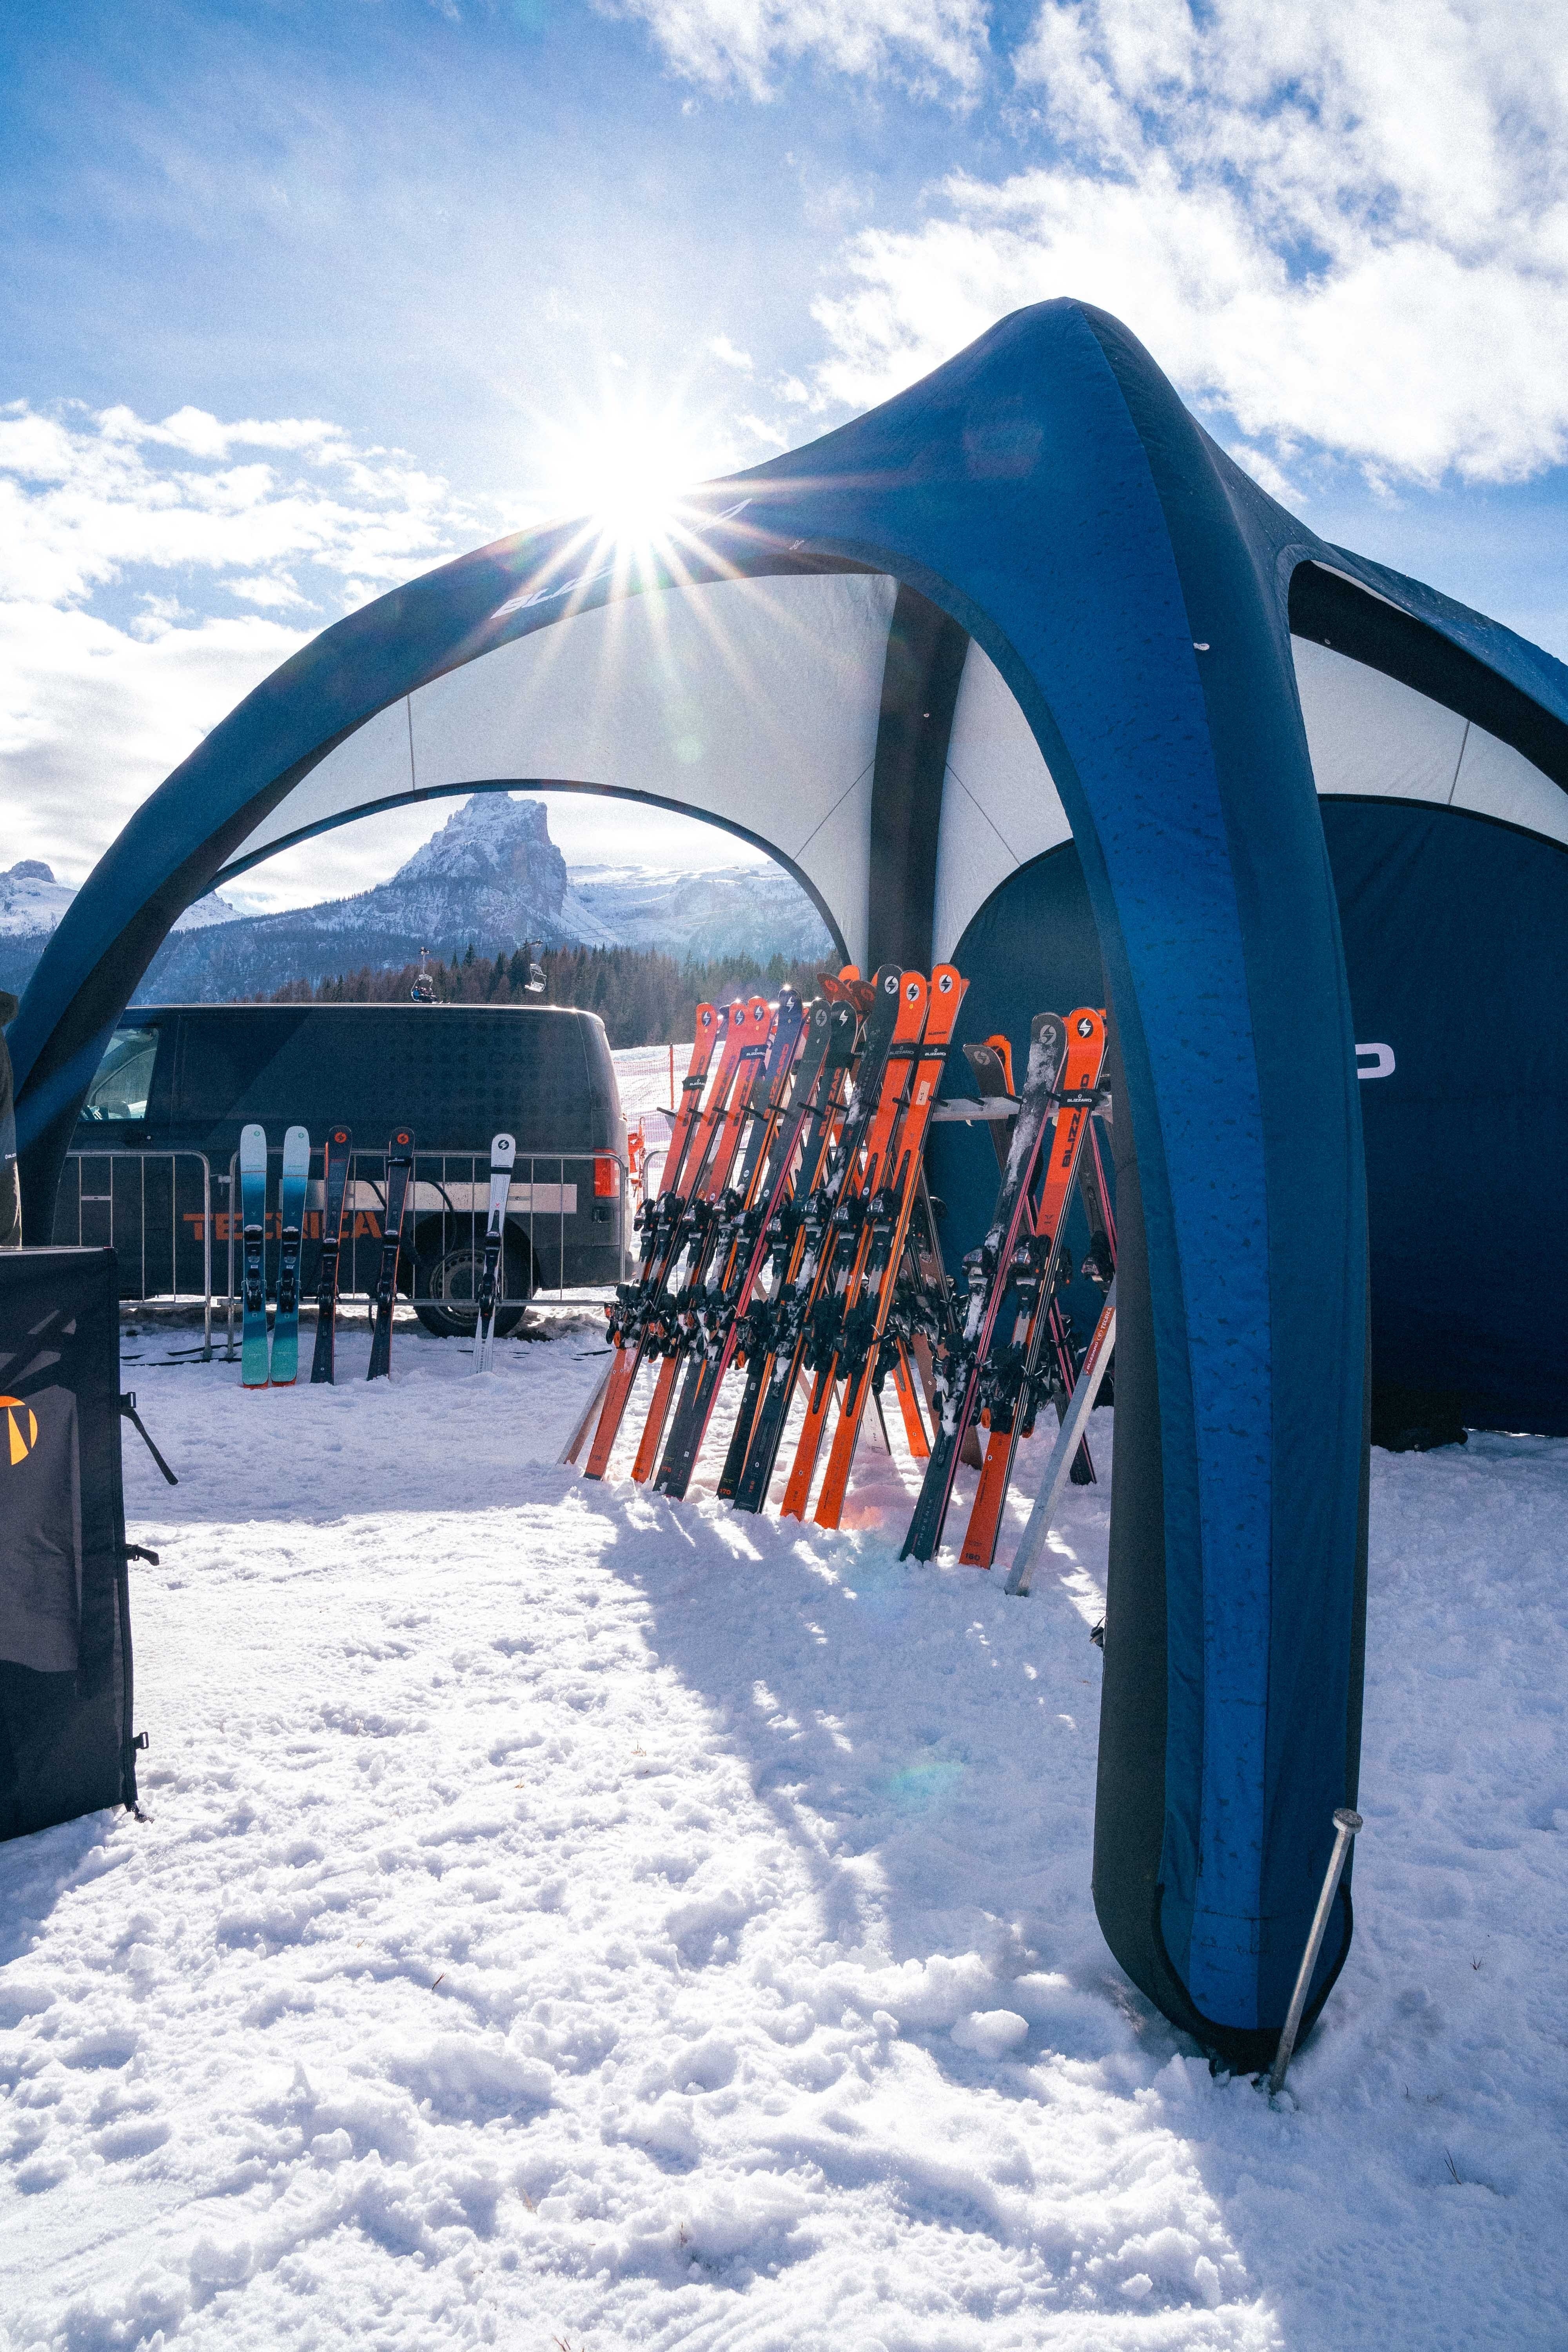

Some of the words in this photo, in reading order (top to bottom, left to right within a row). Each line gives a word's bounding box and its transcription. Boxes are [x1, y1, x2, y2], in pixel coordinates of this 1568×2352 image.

[1087, 1341, 1098, 1370] BLIZZARD
[1101, 1307, 1112, 1329] TECNICA
[917, 1499, 933, 1546] PHOENIX
